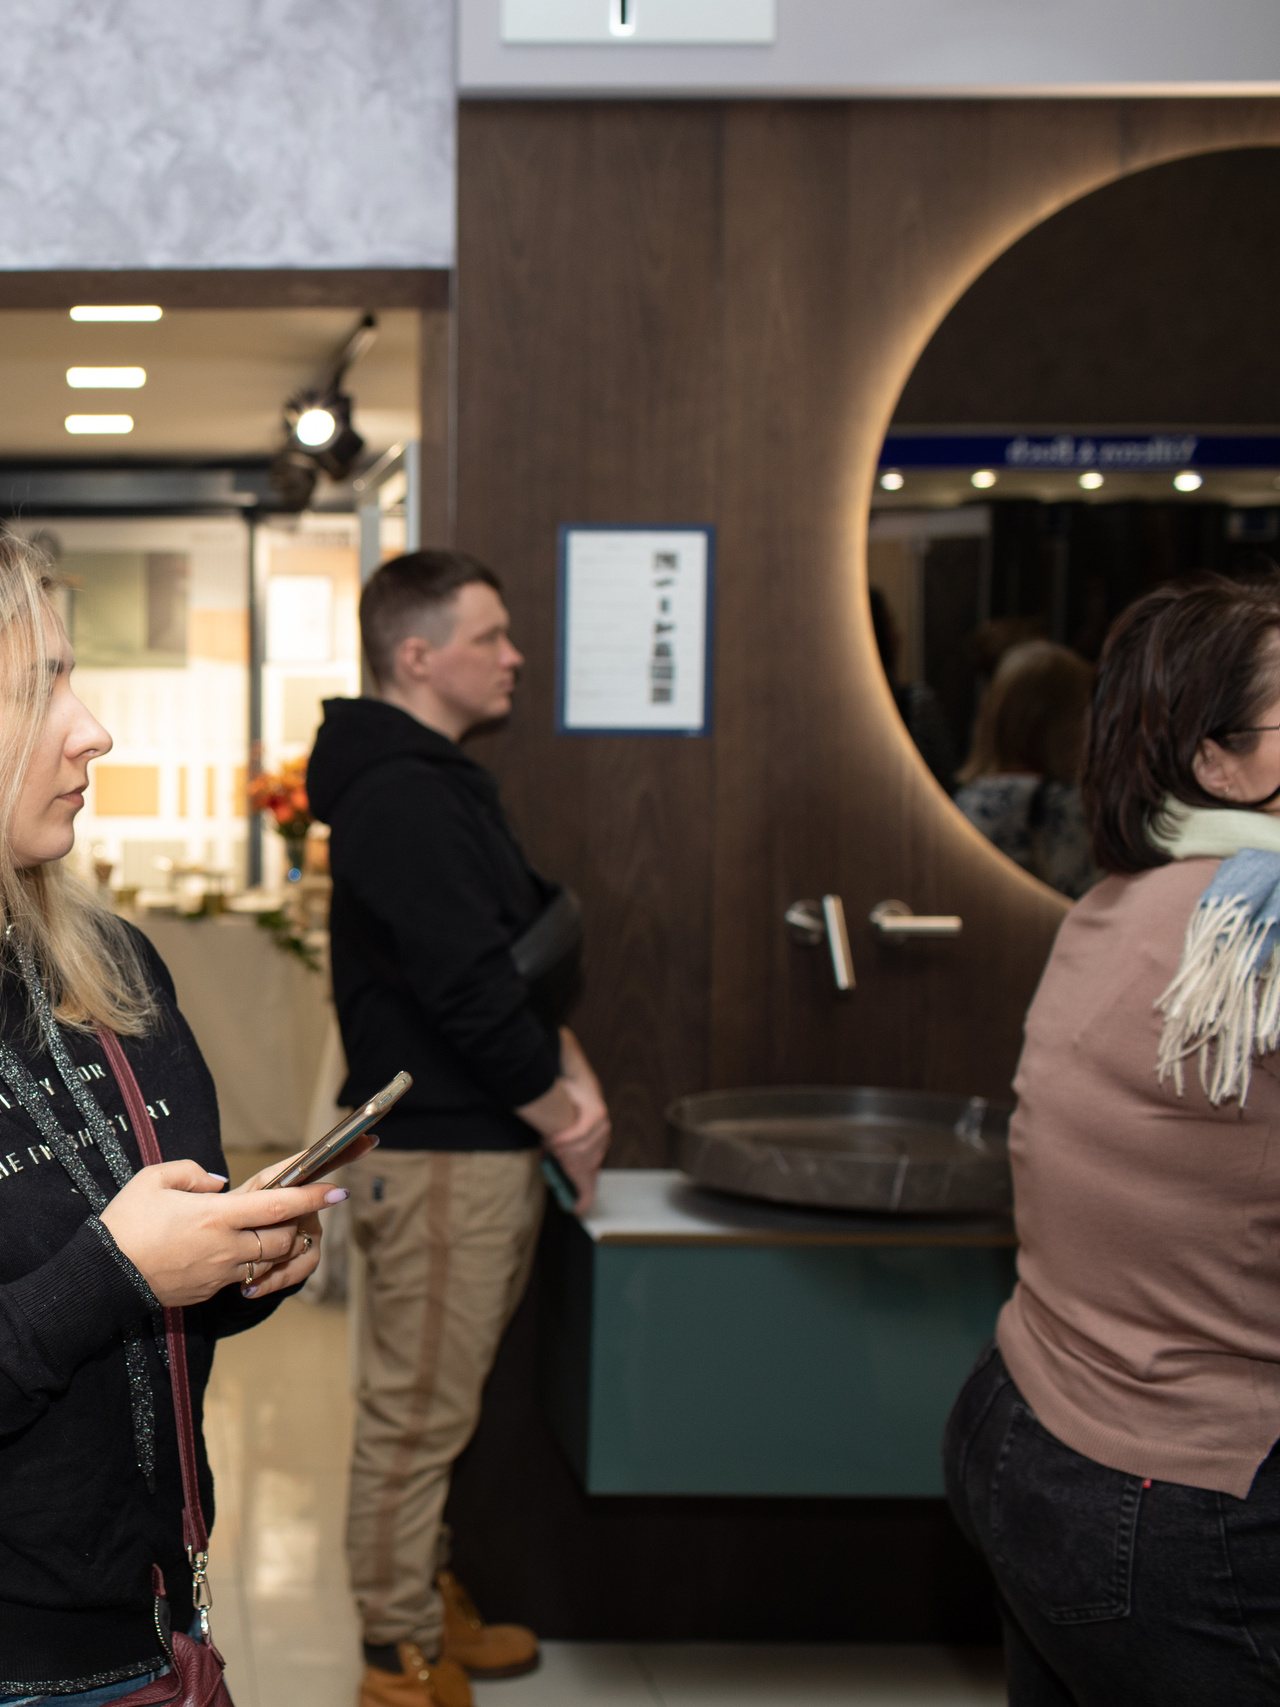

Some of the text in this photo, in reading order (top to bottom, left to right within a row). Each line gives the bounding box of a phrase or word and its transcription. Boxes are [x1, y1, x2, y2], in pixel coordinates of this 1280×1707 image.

[69, 1062, 107, 1085] OR
[27, 1127, 94, 1165] FRSH
[104, 1098, 171, 1137] STRT
